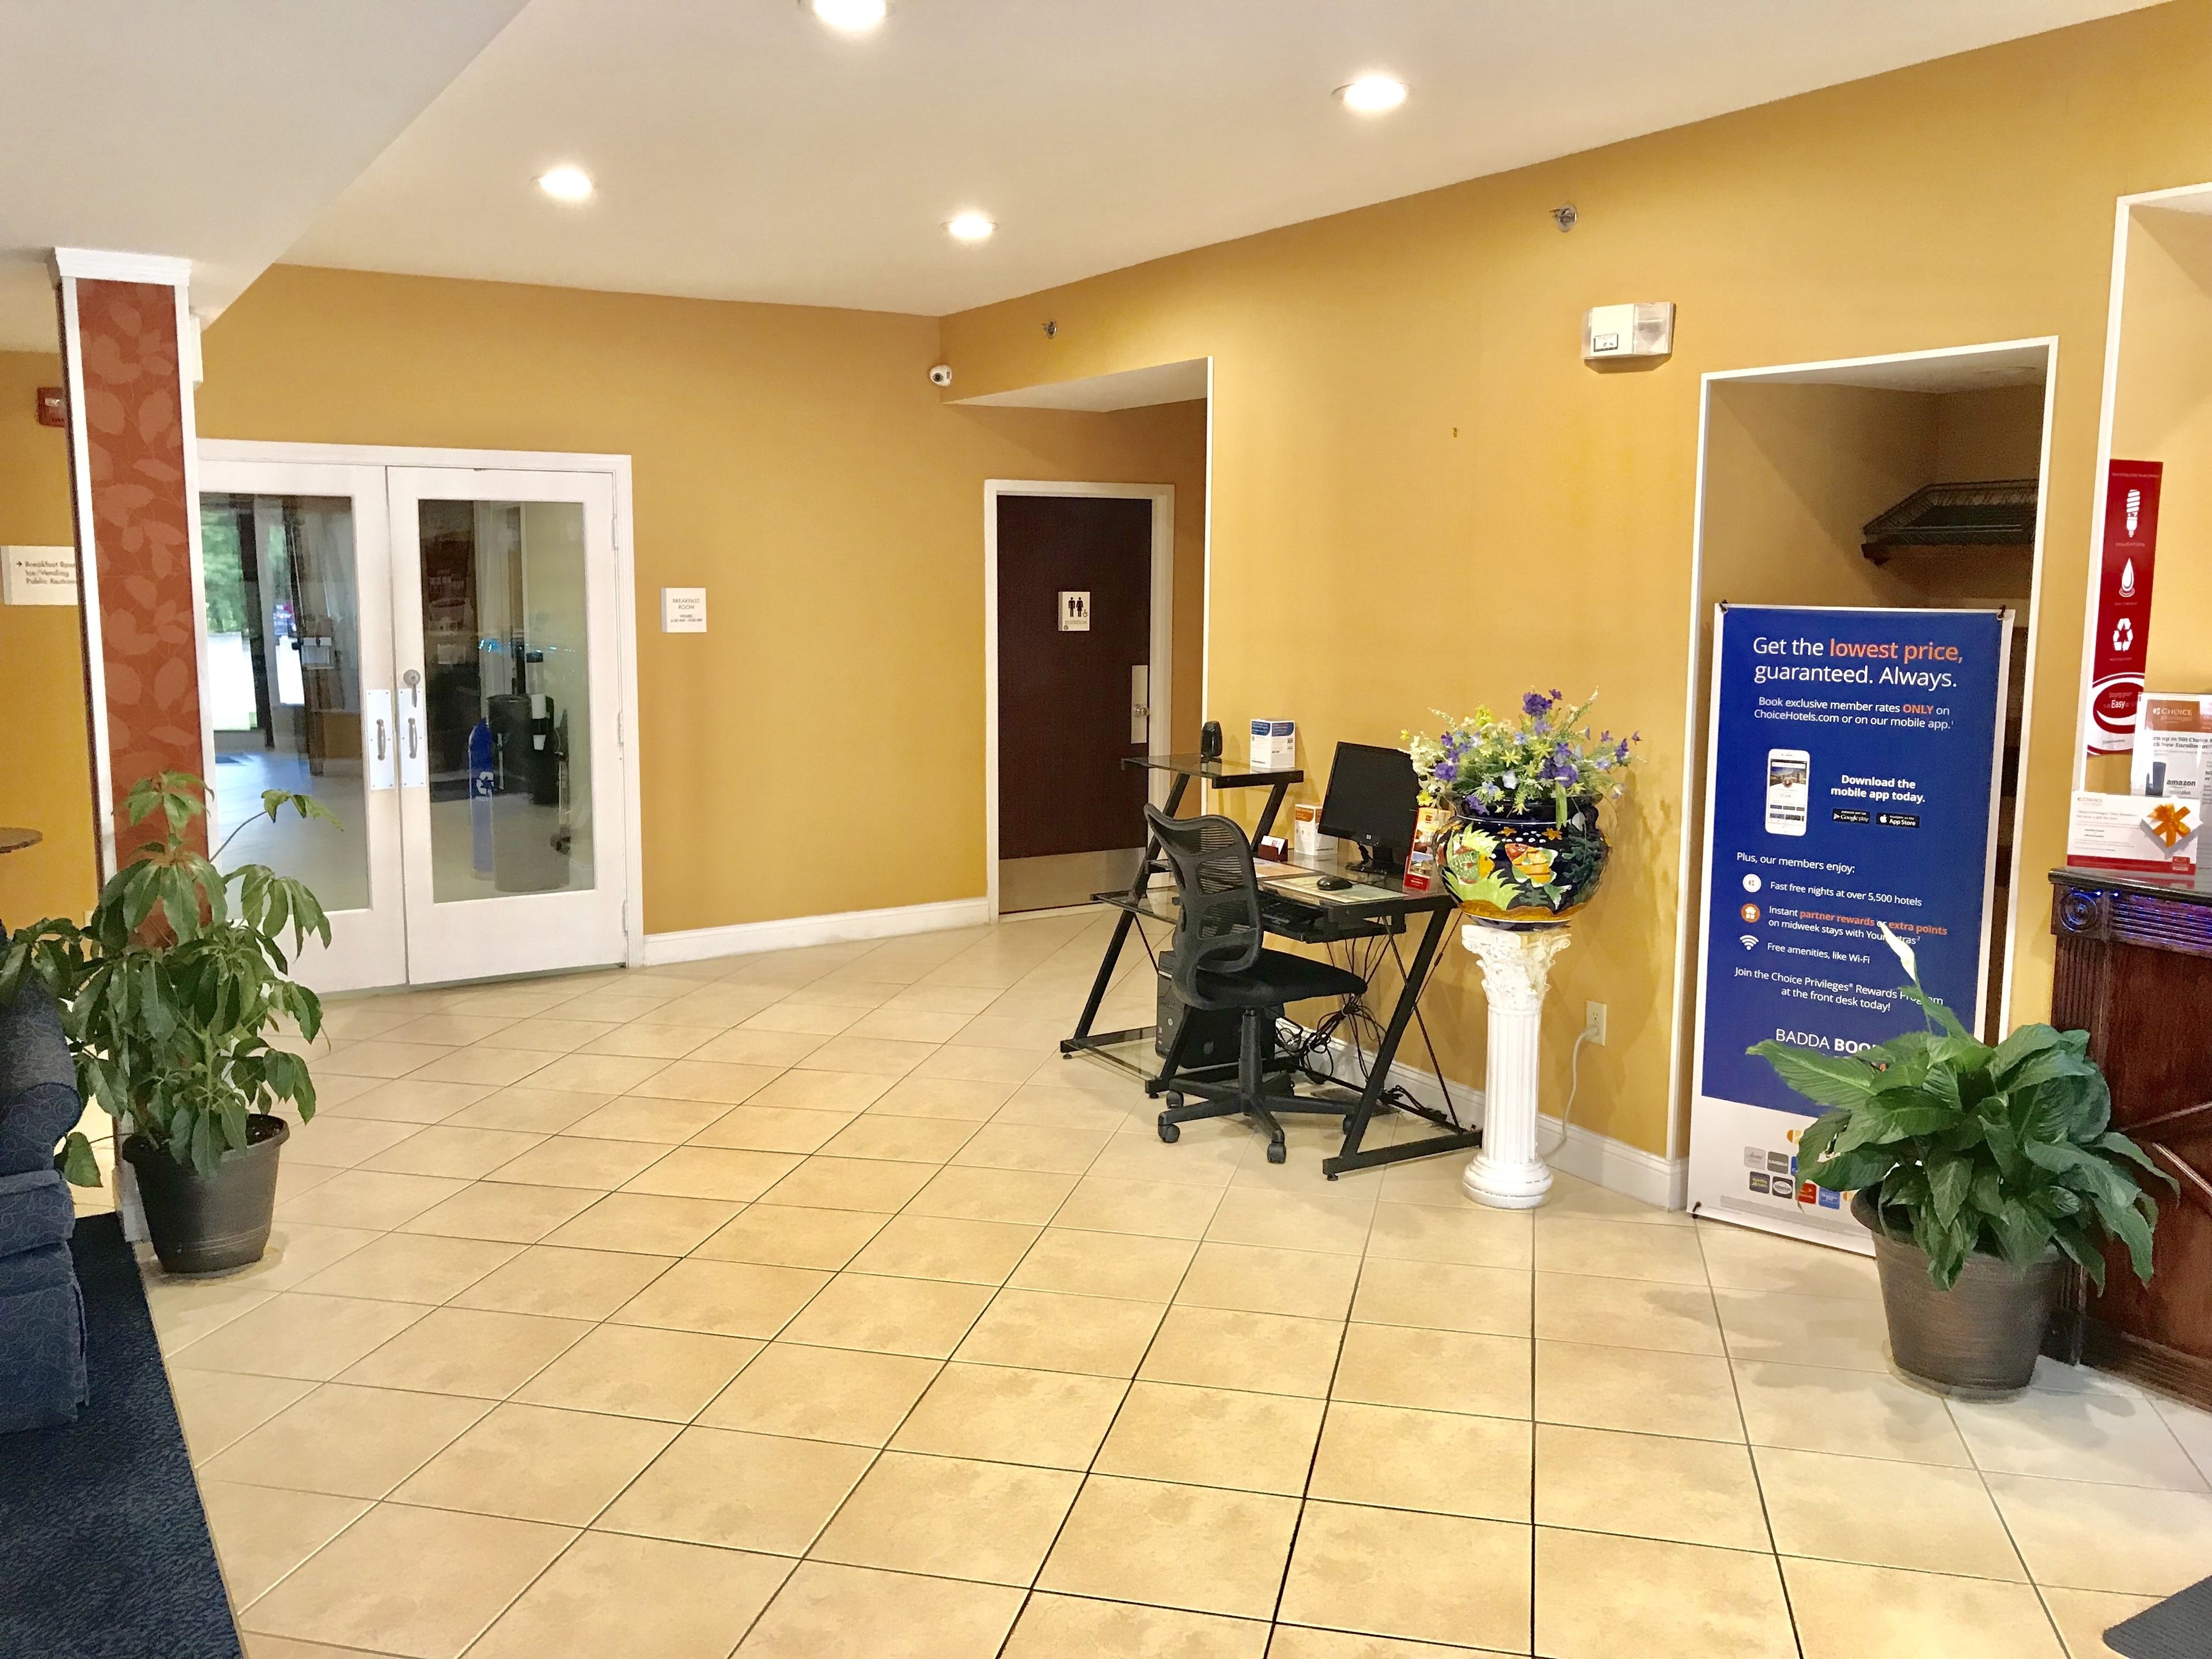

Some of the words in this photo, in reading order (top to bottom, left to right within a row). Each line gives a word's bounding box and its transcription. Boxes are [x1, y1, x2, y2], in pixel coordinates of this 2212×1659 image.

[1753, 637, 1787, 656] Get
[1791, 638, 1824, 657] the
[1830, 639, 1899, 659] lowest
[1904, 642, 1963, 664] price,
[1754, 665, 1874, 684] guaranteed.
[1878, 669, 1957, 691] Always.
[1759, 696, 1783, 707] Book
[1785, 698, 1828, 710] exclusive
[1830, 699, 1873, 712] member
[1874, 702, 1900, 713] rates
[1903, 703, 1934, 714] ONLY
[1936, 707, 1950, 715] on
[2111, 699, 2126, 709] Easy
[1754, 709, 1839, 724] ChoiceHotels.com
[1842, 715, 1853, 724] or
[1854, 715, 1868, 725] on
[1870, 717, 1888, 726] our
[1890, 717, 1926, 728] mobile
[1841, 775, 1895, 788] Download
[1897, 778, 1916, 789] the
[1831, 786, 1866, 799] mobile
[1869, 789, 1889, 801] app
[1891, 790, 1926, 804] today.
[1737, 852, 1758, 864] Plus,
[1760, 856, 1777, 864] our
[1779, 858, 1824, 870] members
[1826, 862, 1855, 875] enjoy:
[1770, 881, 1788, 891] Fast
[1789, 883, 1806, 893] free
[1808, 886, 1834, 897] nights
[1847, 892, 1866, 900] over
[1868, 892, 1892, 903] 5,500
[1894, 895, 1922, 906] hotels
[1769, 906, 1798, 917] Instant
[1800, 911, 1835, 921] partner
[1837, 916, 1874, 926] rewards
[1888, 921, 1914, 931] extra
[1916, 925, 1948, 935] points
[1781, 921, 1820, 933] midweek
[1821, 926, 1843, 937] stays
[1845, 928, 1864, 938] with
[1767, 942, 1786, 953] Free
[1787, 946, 1830, 960] amenities,
[1832, 950, 1847, 961] like
[1849, 953, 1871, 964] Wi-Fi
[1734, 967, 1752, 977] Join
[1754, 970, 1769, 979] the
[1771, 972, 1802, 984] Choice
[1855, 984, 1897, 999] Rewards
[1781, 987, 1791, 995] at
[1793, 988, 1808, 999] the
[1810, 990, 1834, 1003] front
[1835, 995, 1858, 1006] desk
[1860, 999, 1891, 1013] today!
[1775, 1028, 1830, 1050] BADDA
[1834, 1037, 1880, 1055] BOO
